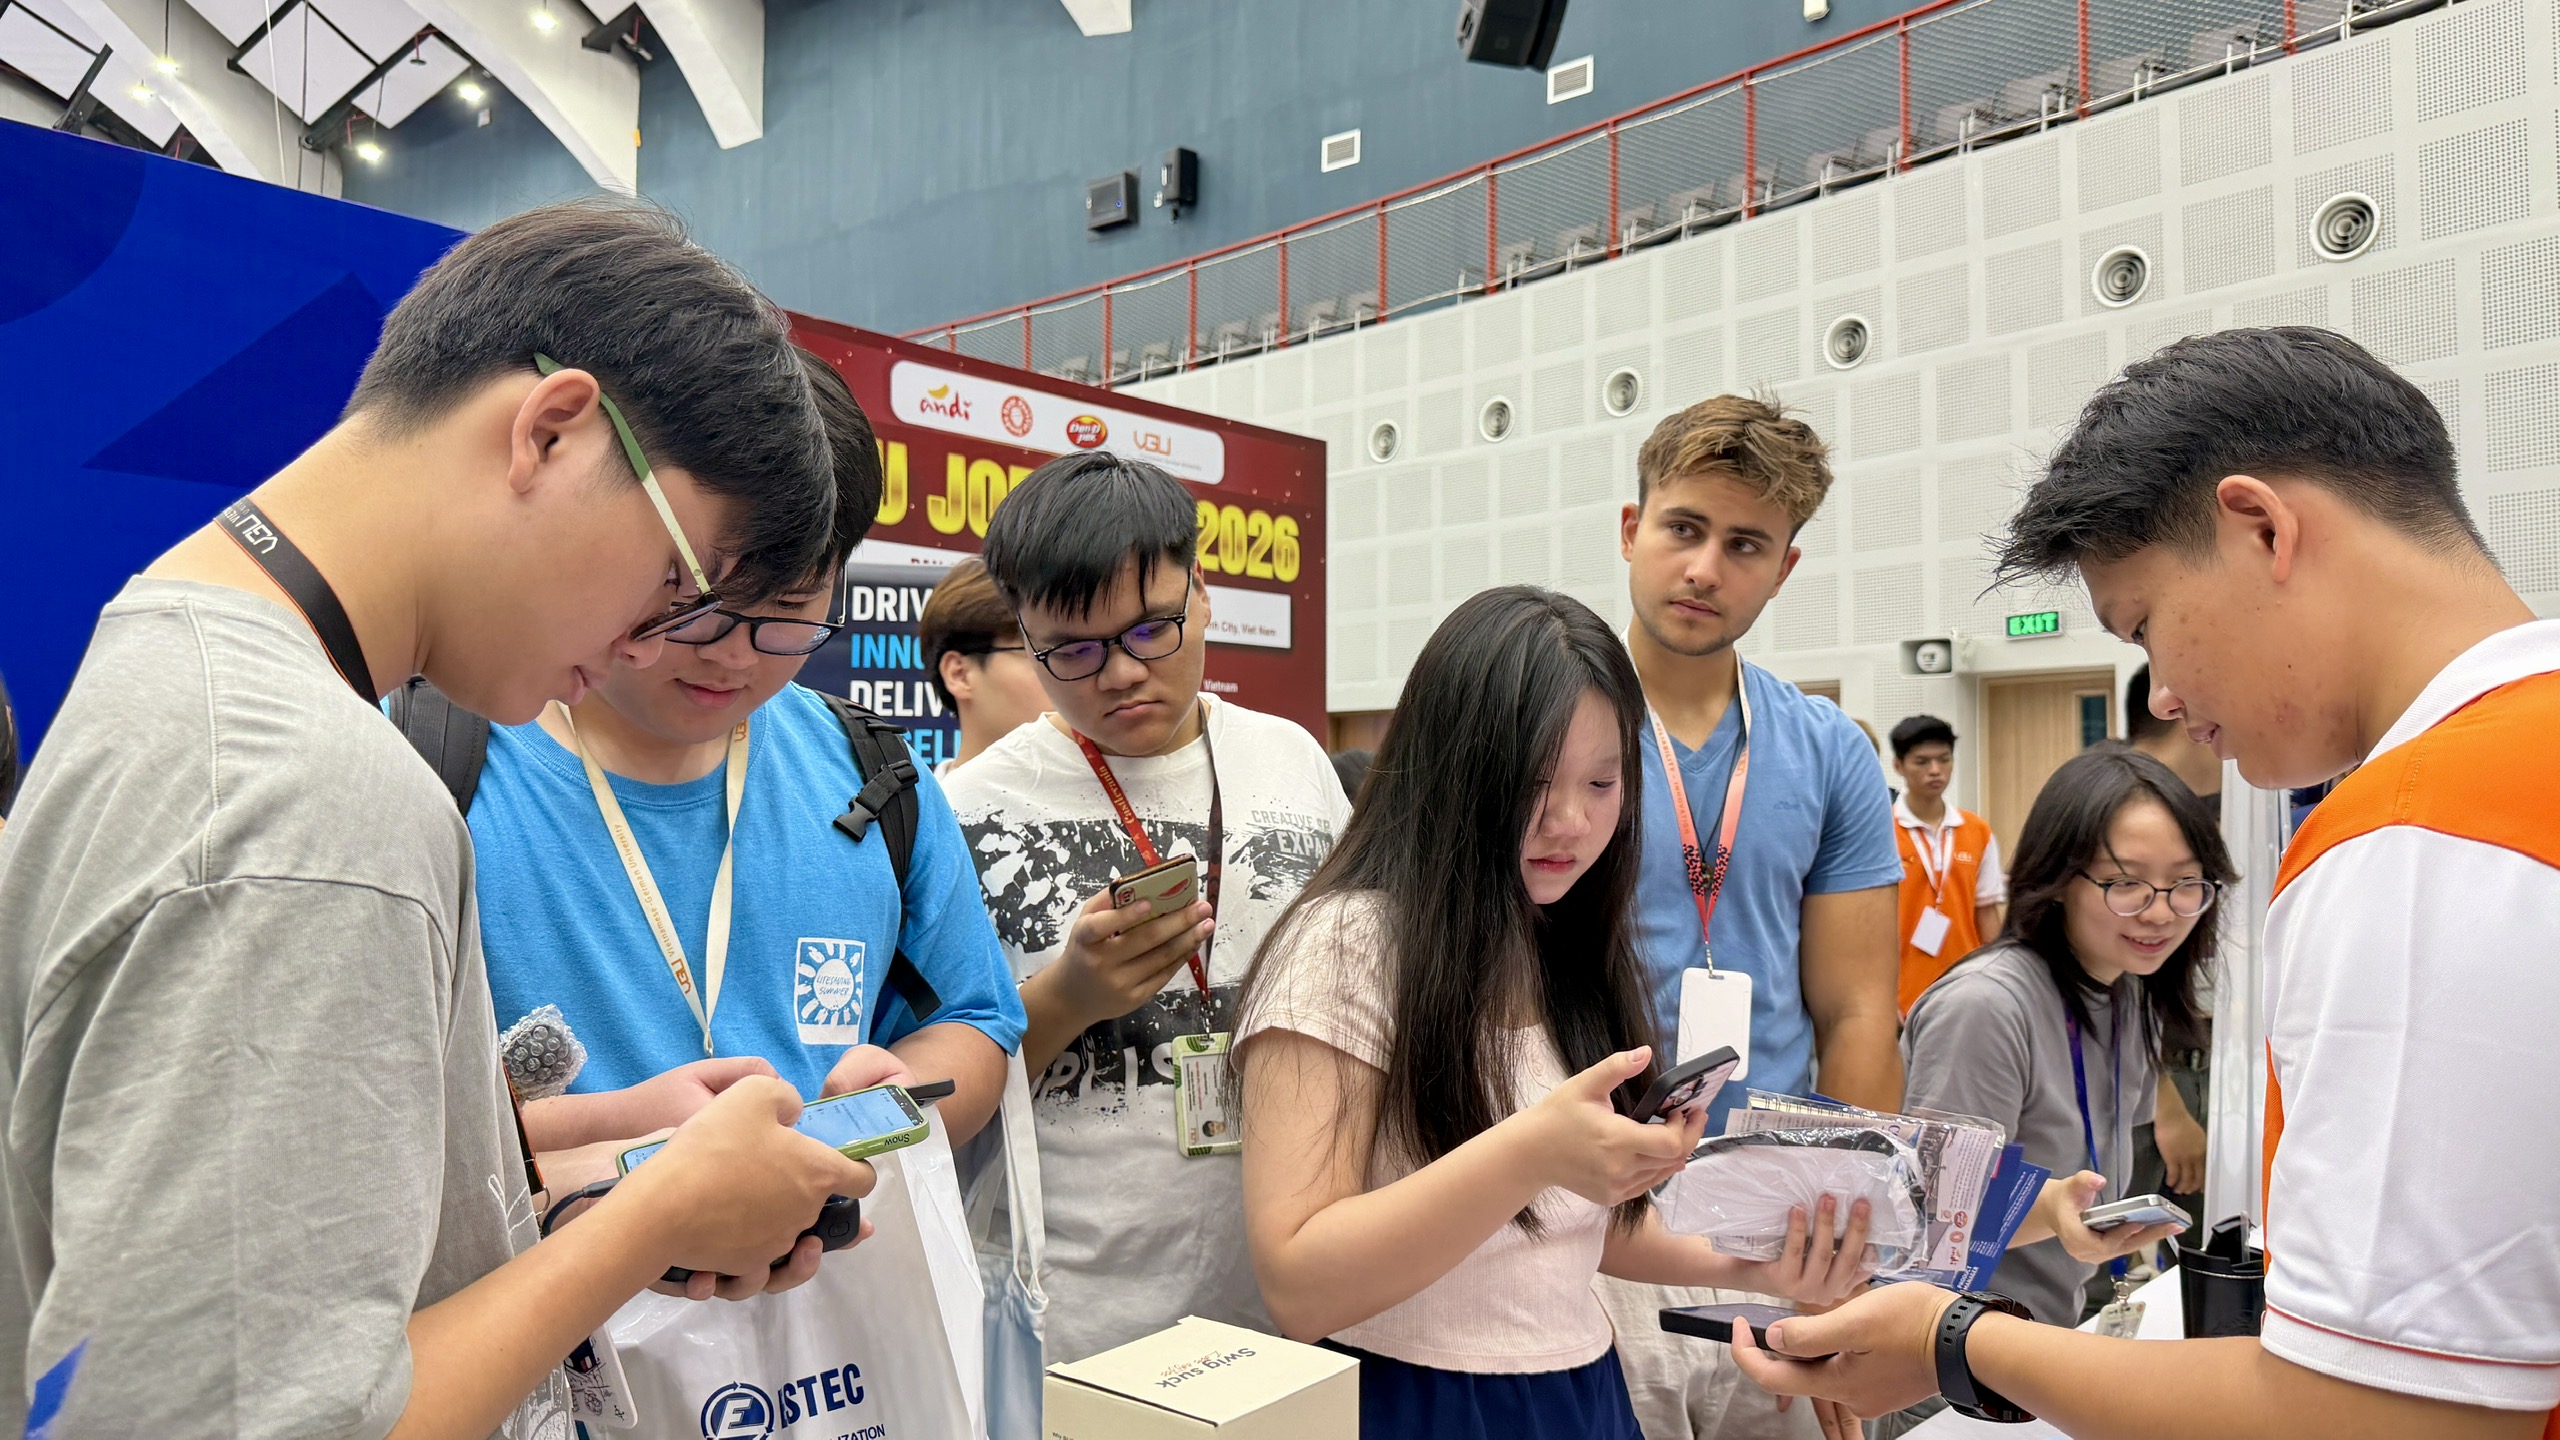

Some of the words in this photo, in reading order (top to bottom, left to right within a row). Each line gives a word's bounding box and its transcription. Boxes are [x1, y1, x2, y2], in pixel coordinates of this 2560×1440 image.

[926, 452, 1036, 540] JO
[1197, 500, 1301, 583] 2026
[2009, 612, 2058, 636] EXIT
[1203, 679, 1239, 693] Vietnam
[1099, 765, 1135, 824] Castlevania
[1251, 810, 1313, 828] CREATIVE
[613, 823, 638, 869] University
[819, 986, 850, 996] SUMMER
[884, 1133, 910, 1146] Snow
[1202, 1347, 1257, 1369] Swig
[1154, 1367, 1205, 1388] suck
